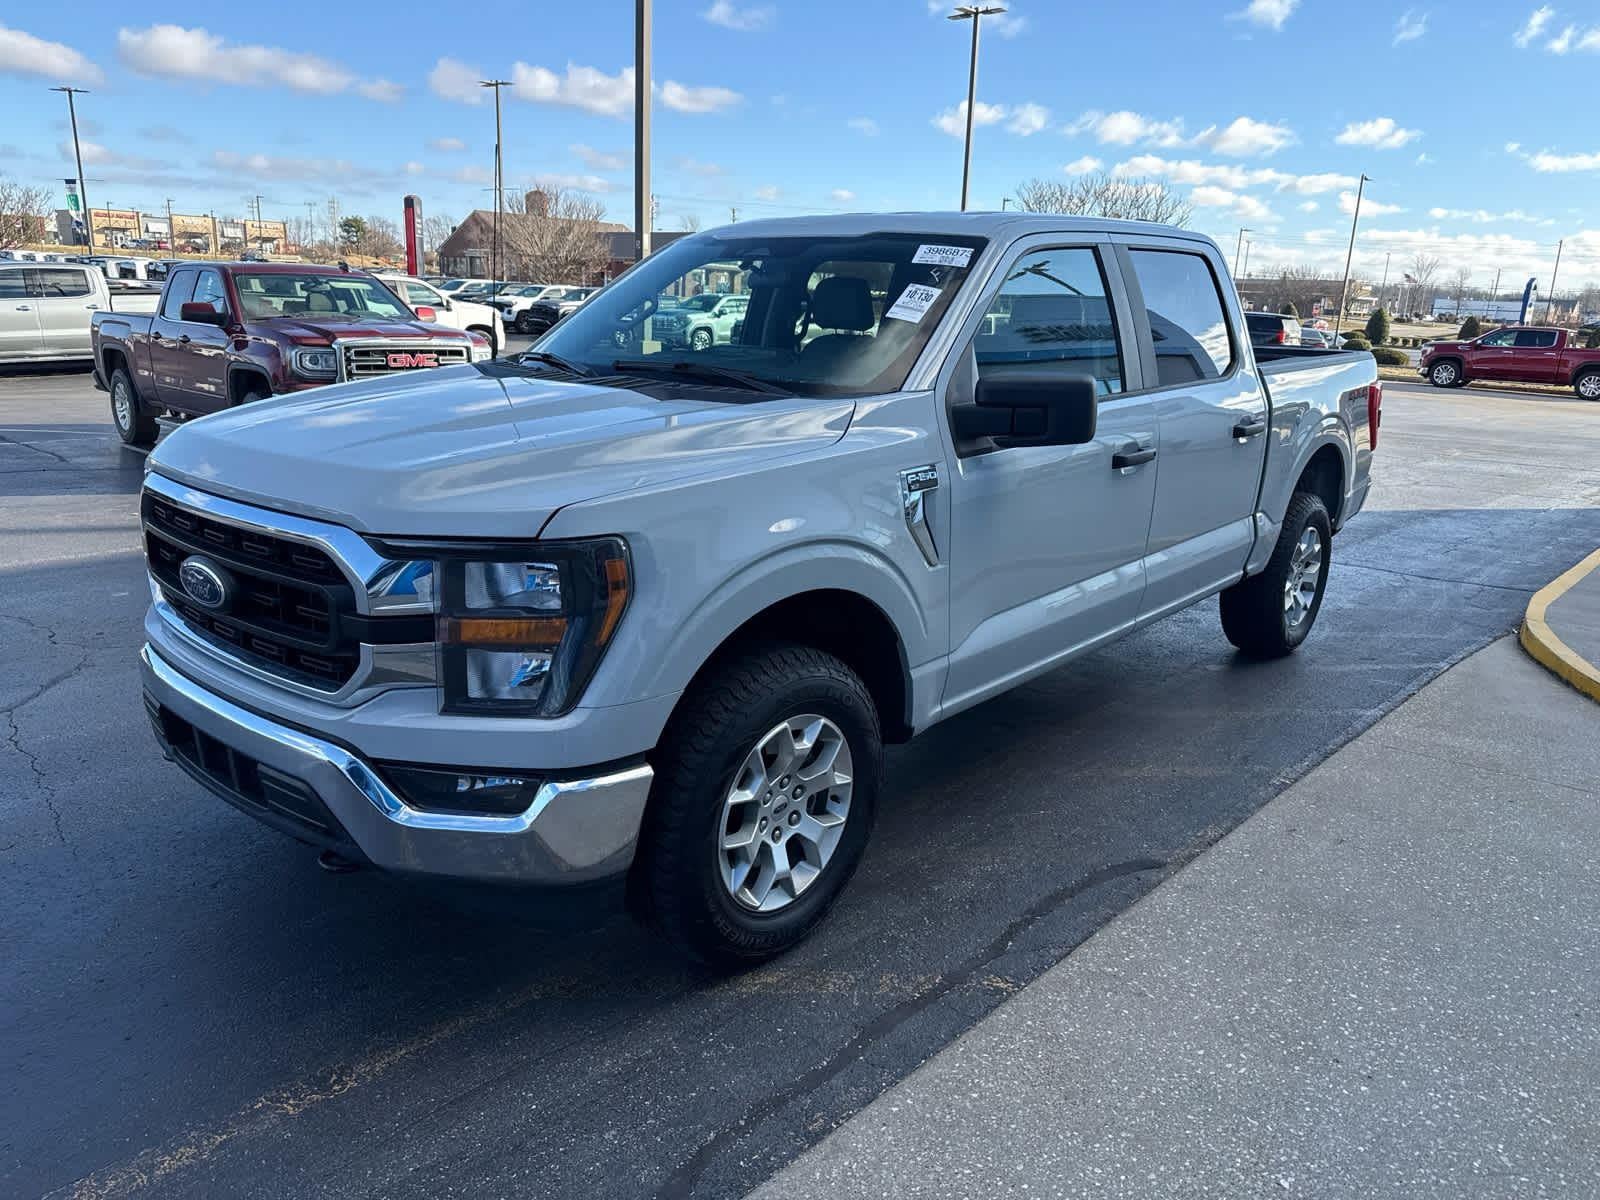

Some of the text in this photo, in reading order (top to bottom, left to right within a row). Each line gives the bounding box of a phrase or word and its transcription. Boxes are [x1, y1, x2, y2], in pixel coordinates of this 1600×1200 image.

[387, 353, 438, 367] GMC
[907, 471, 937, 484] F-150
[186, 570, 212, 599] Ford
